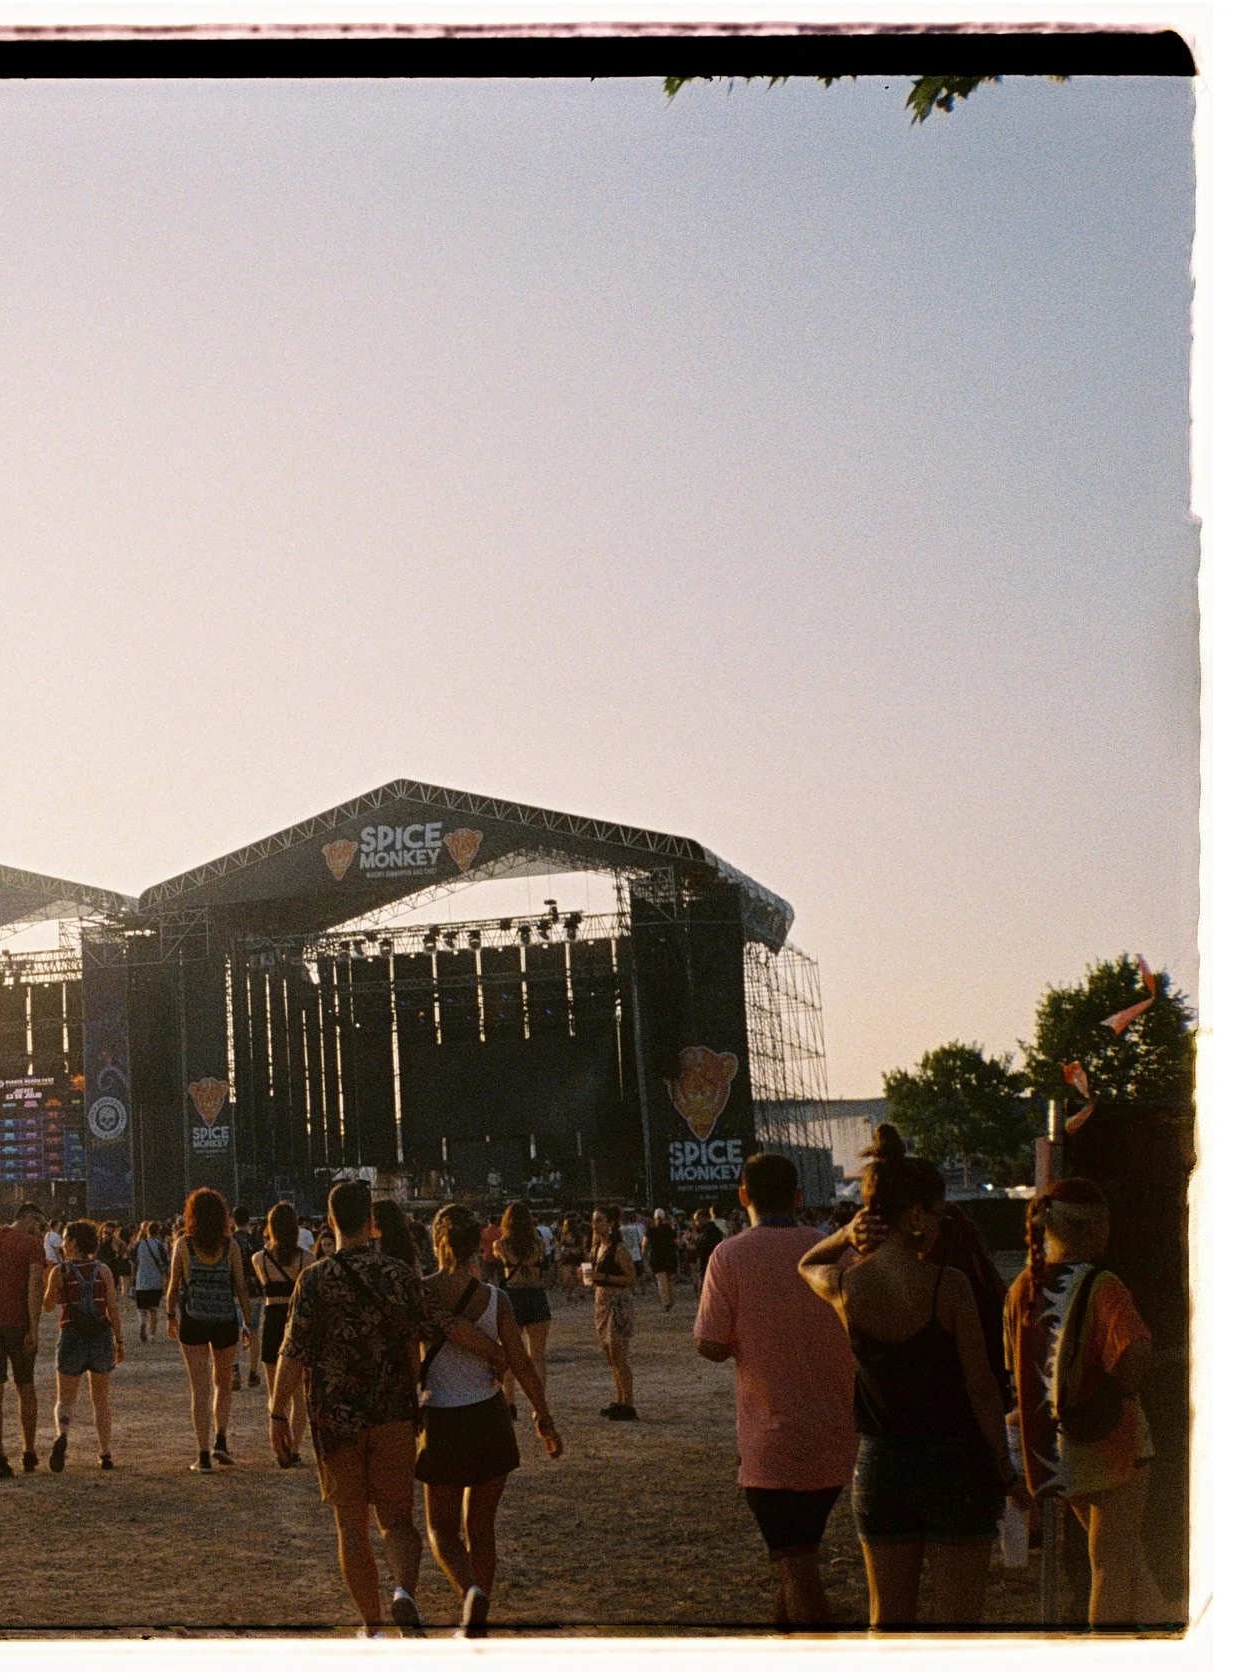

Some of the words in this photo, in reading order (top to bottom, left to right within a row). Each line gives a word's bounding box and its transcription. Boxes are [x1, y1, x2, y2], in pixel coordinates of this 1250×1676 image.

[360, 822, 443, 853] SPICE
[359, 848, 442, 870] MONKEY
[192, 1126, 229, 1140] SPICE
[193, 1138, 229, 1148] MONKEY
[669, 1139, 743, 1165] SPICE
[670, 1164, 742, 1181] MONKEY
